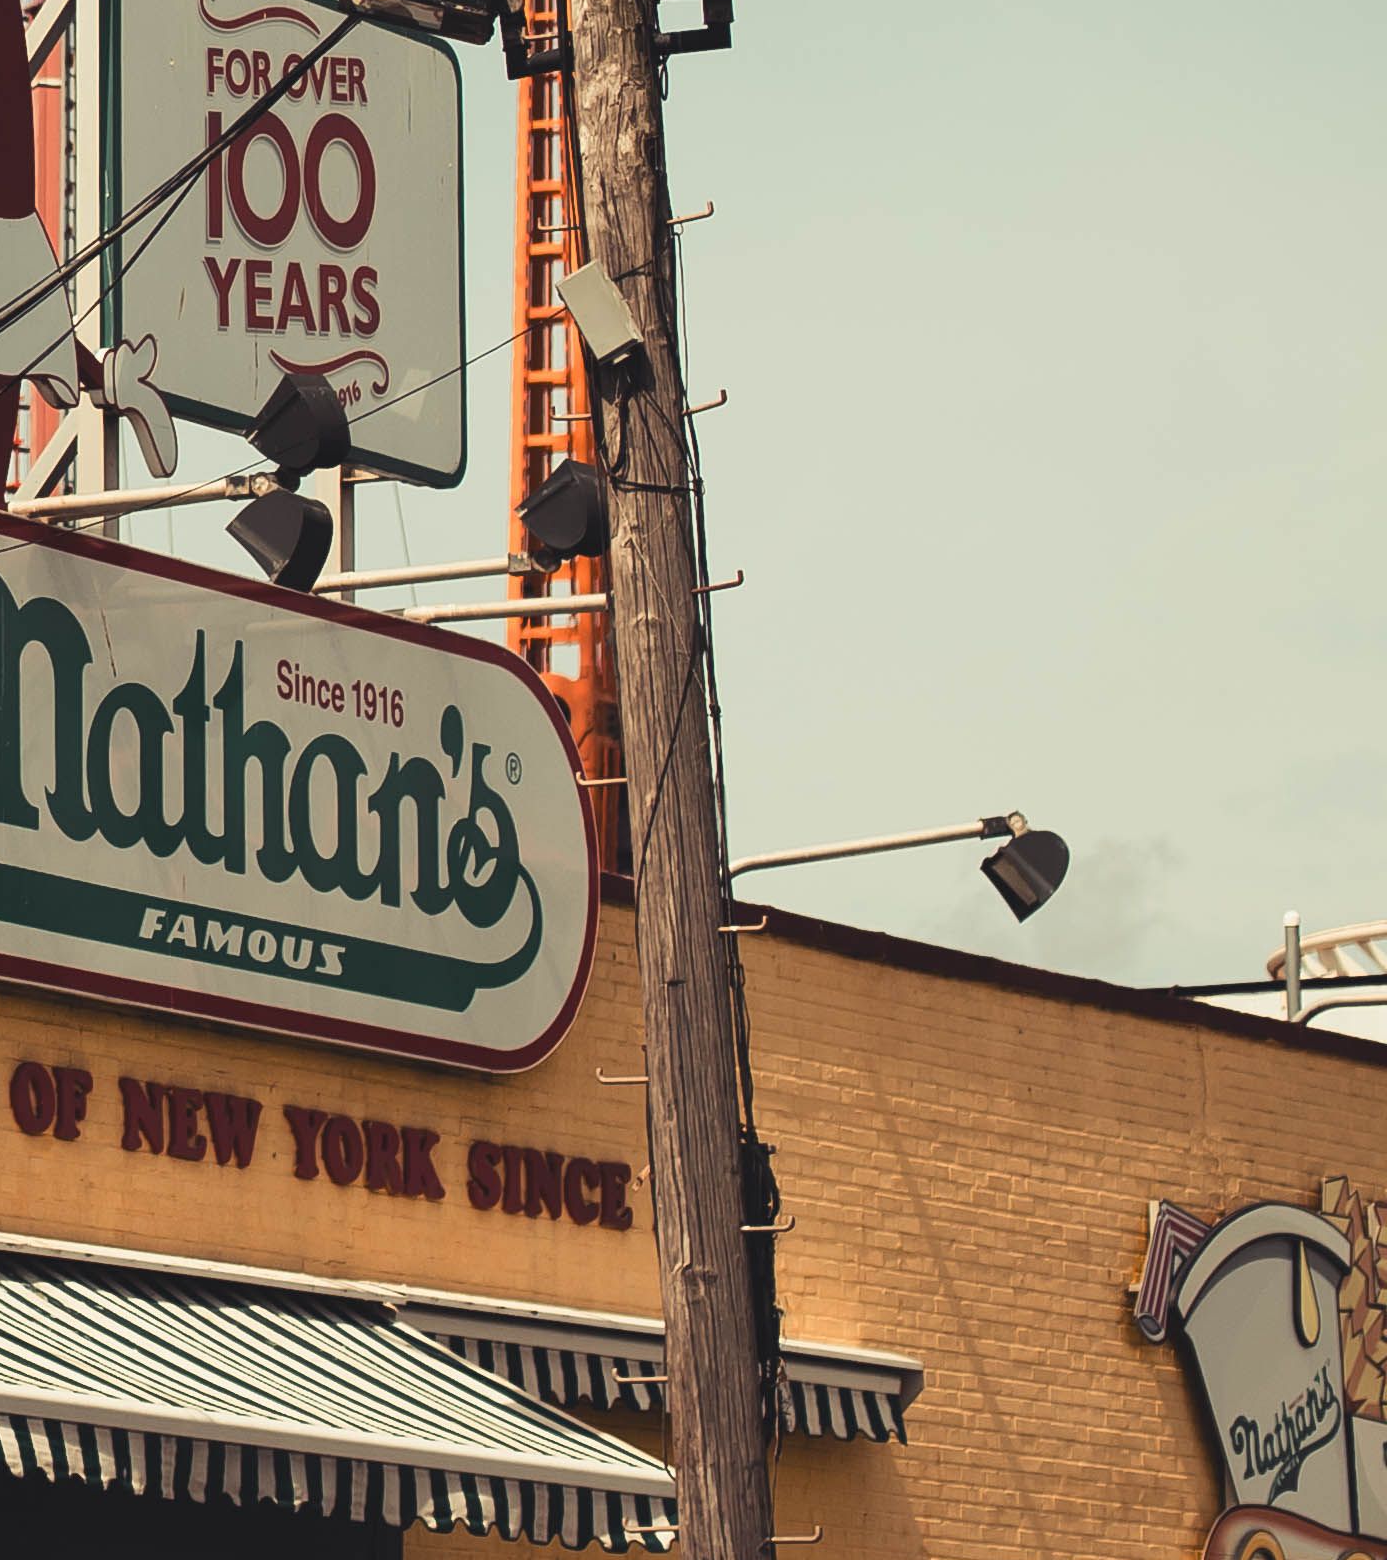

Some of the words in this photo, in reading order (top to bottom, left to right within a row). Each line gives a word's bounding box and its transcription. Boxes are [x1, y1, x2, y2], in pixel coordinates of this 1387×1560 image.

[206, 46, 272, 99] FOR
[281, 52, 369, 106] OVER
[205, 109, 378, 251] 100
[202, 255, 382, 338] YEARS
[333, 379, 362, 411] 916
[275, 657, 346, 716] Since
[351, 679, 406, 730] 1916
[138, 906, 348, 977] FAMOUS
[8, 1060, 94, 1144] OF
[118, 1075, 264, 1170] NEW
[284, 1103, 448, 1203] YORK
[466, 1138, 635, 1231] SINCE
[1229, 1364, 1341, 1481] Nathan's
